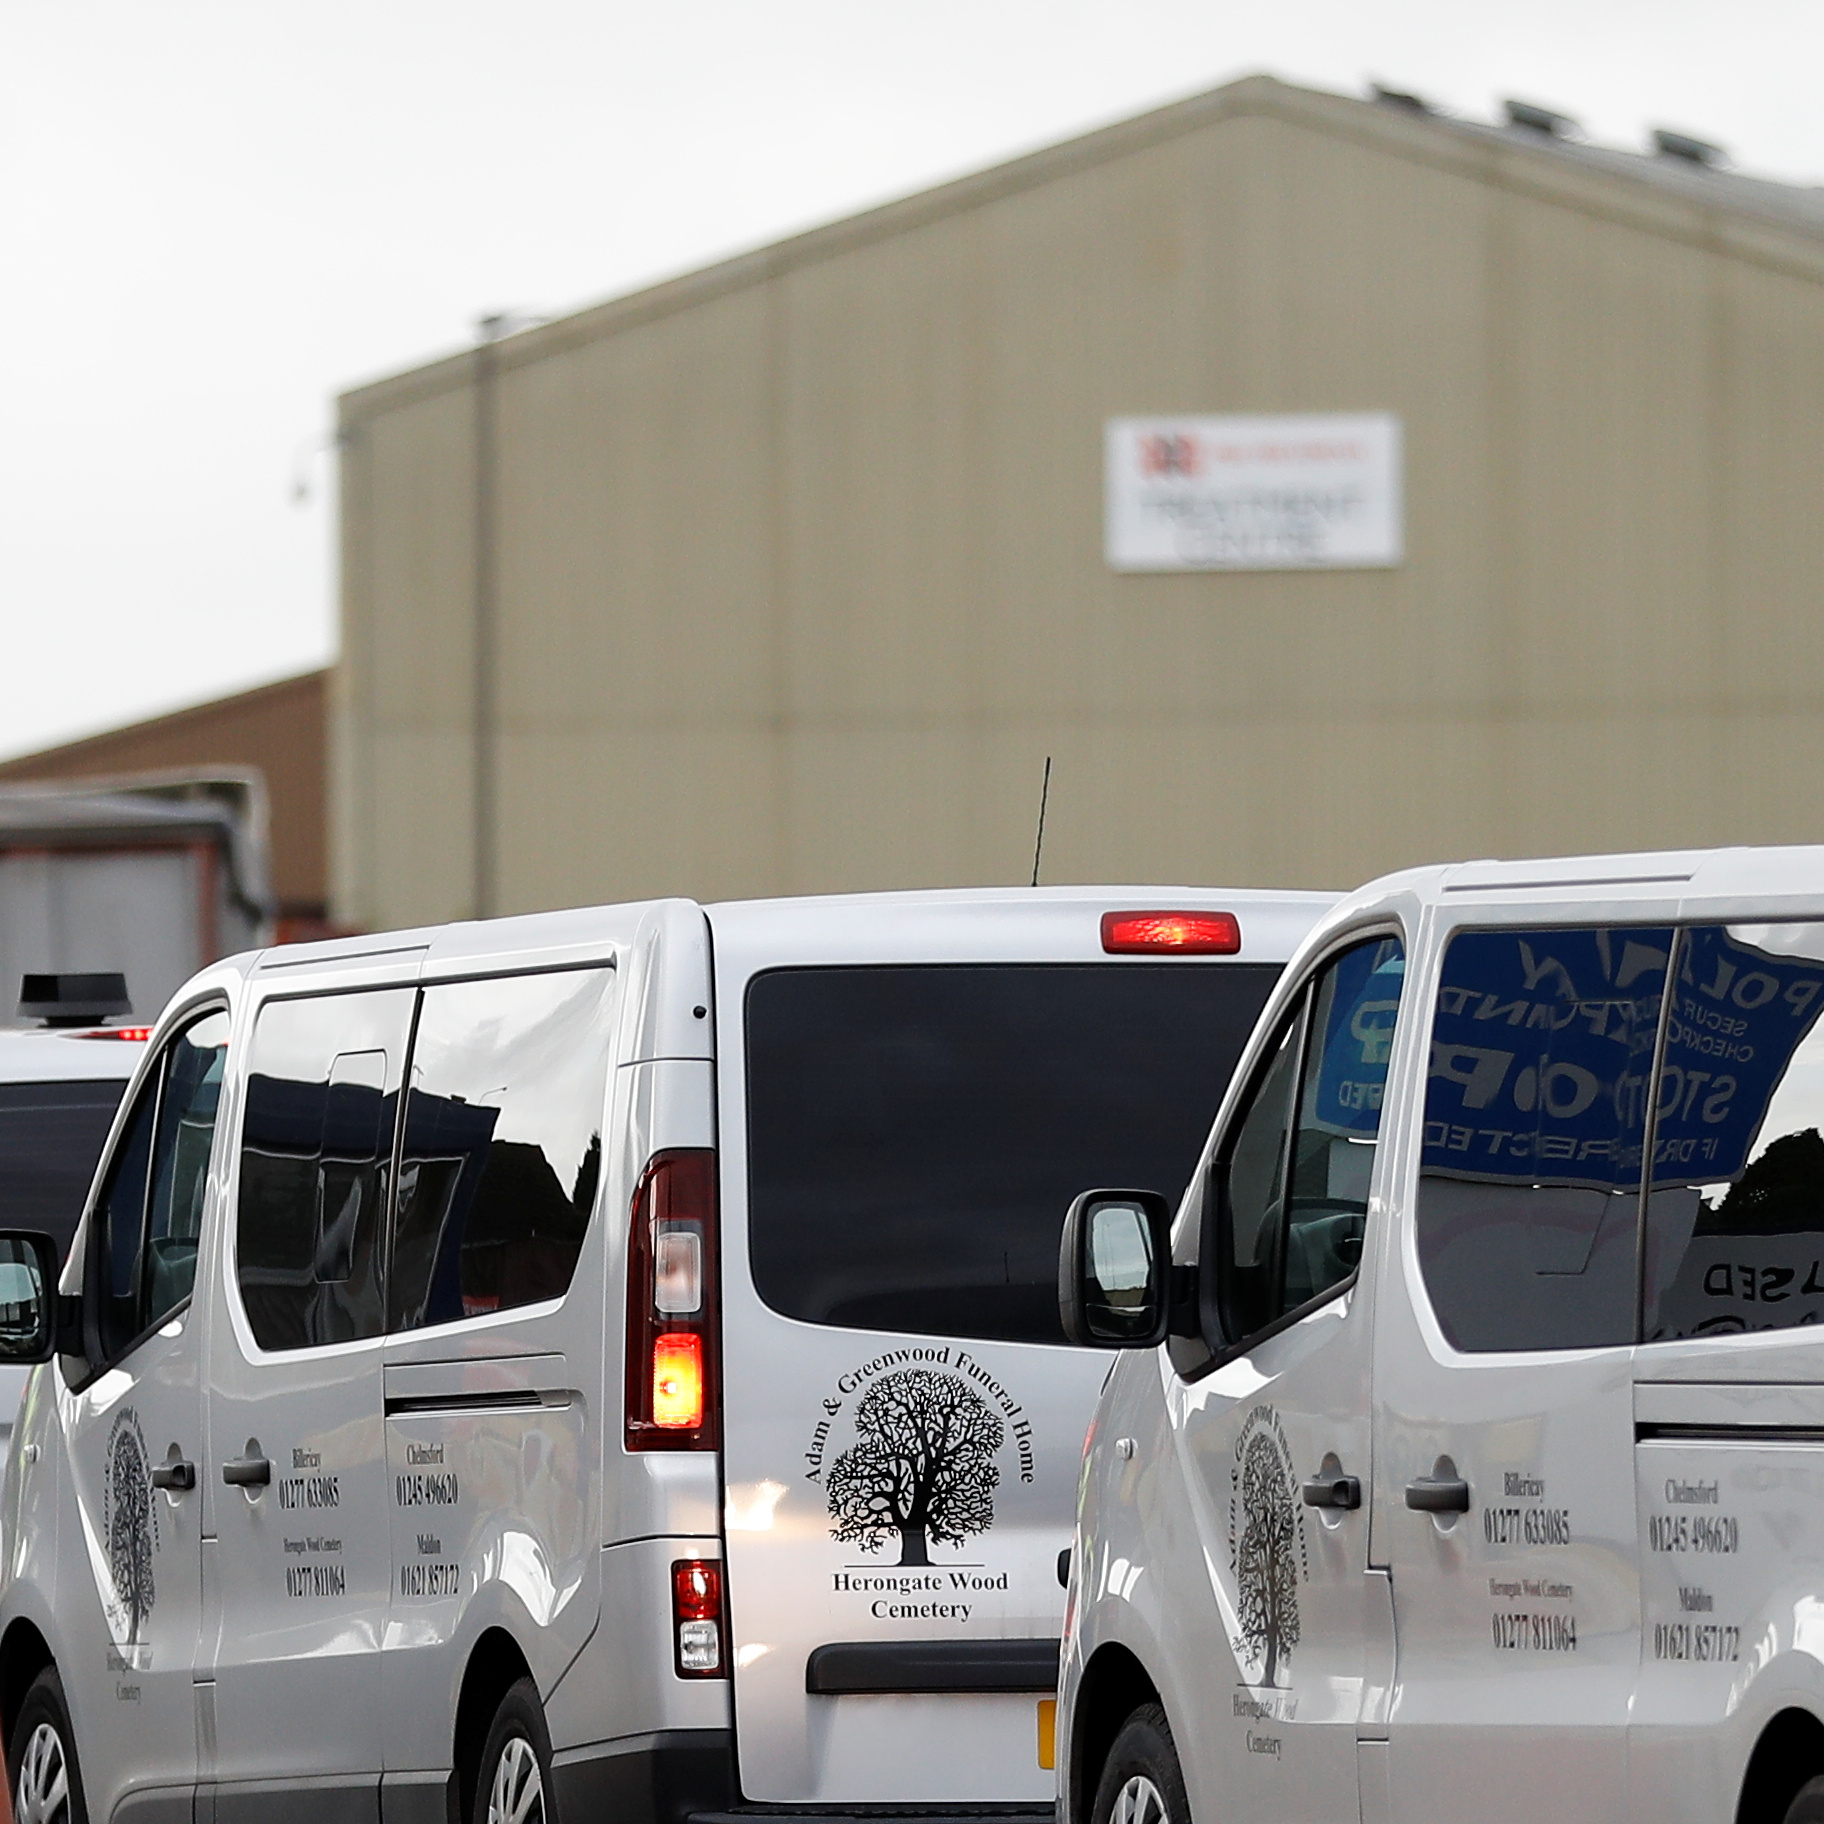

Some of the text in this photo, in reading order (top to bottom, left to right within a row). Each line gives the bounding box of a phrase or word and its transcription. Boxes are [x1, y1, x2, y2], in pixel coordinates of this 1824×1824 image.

[804, 1346, 1035, 1485] Adam & Greenwood Funeral Home
[279, 1477, 340, 1509] 01277 633085
[396, 1473, 458, 1506] 01245 496620
[1484, 1508, 1570, 1545] 01277 633085
[1649, 1516, 1738, 1553] 01245 496620
[286, 1565, 345, 1597] 01277 811064
[401, 1564, 459, 1596] 01621 857172
[832, 1573, 1009, 1595] Herongate Wood
[871, 1600, 972, 1622] Cemetery
[1492, 1613, 1576, 1651] 01277 811064
[1654, 1623, 1740, 1661] 01621 857172
